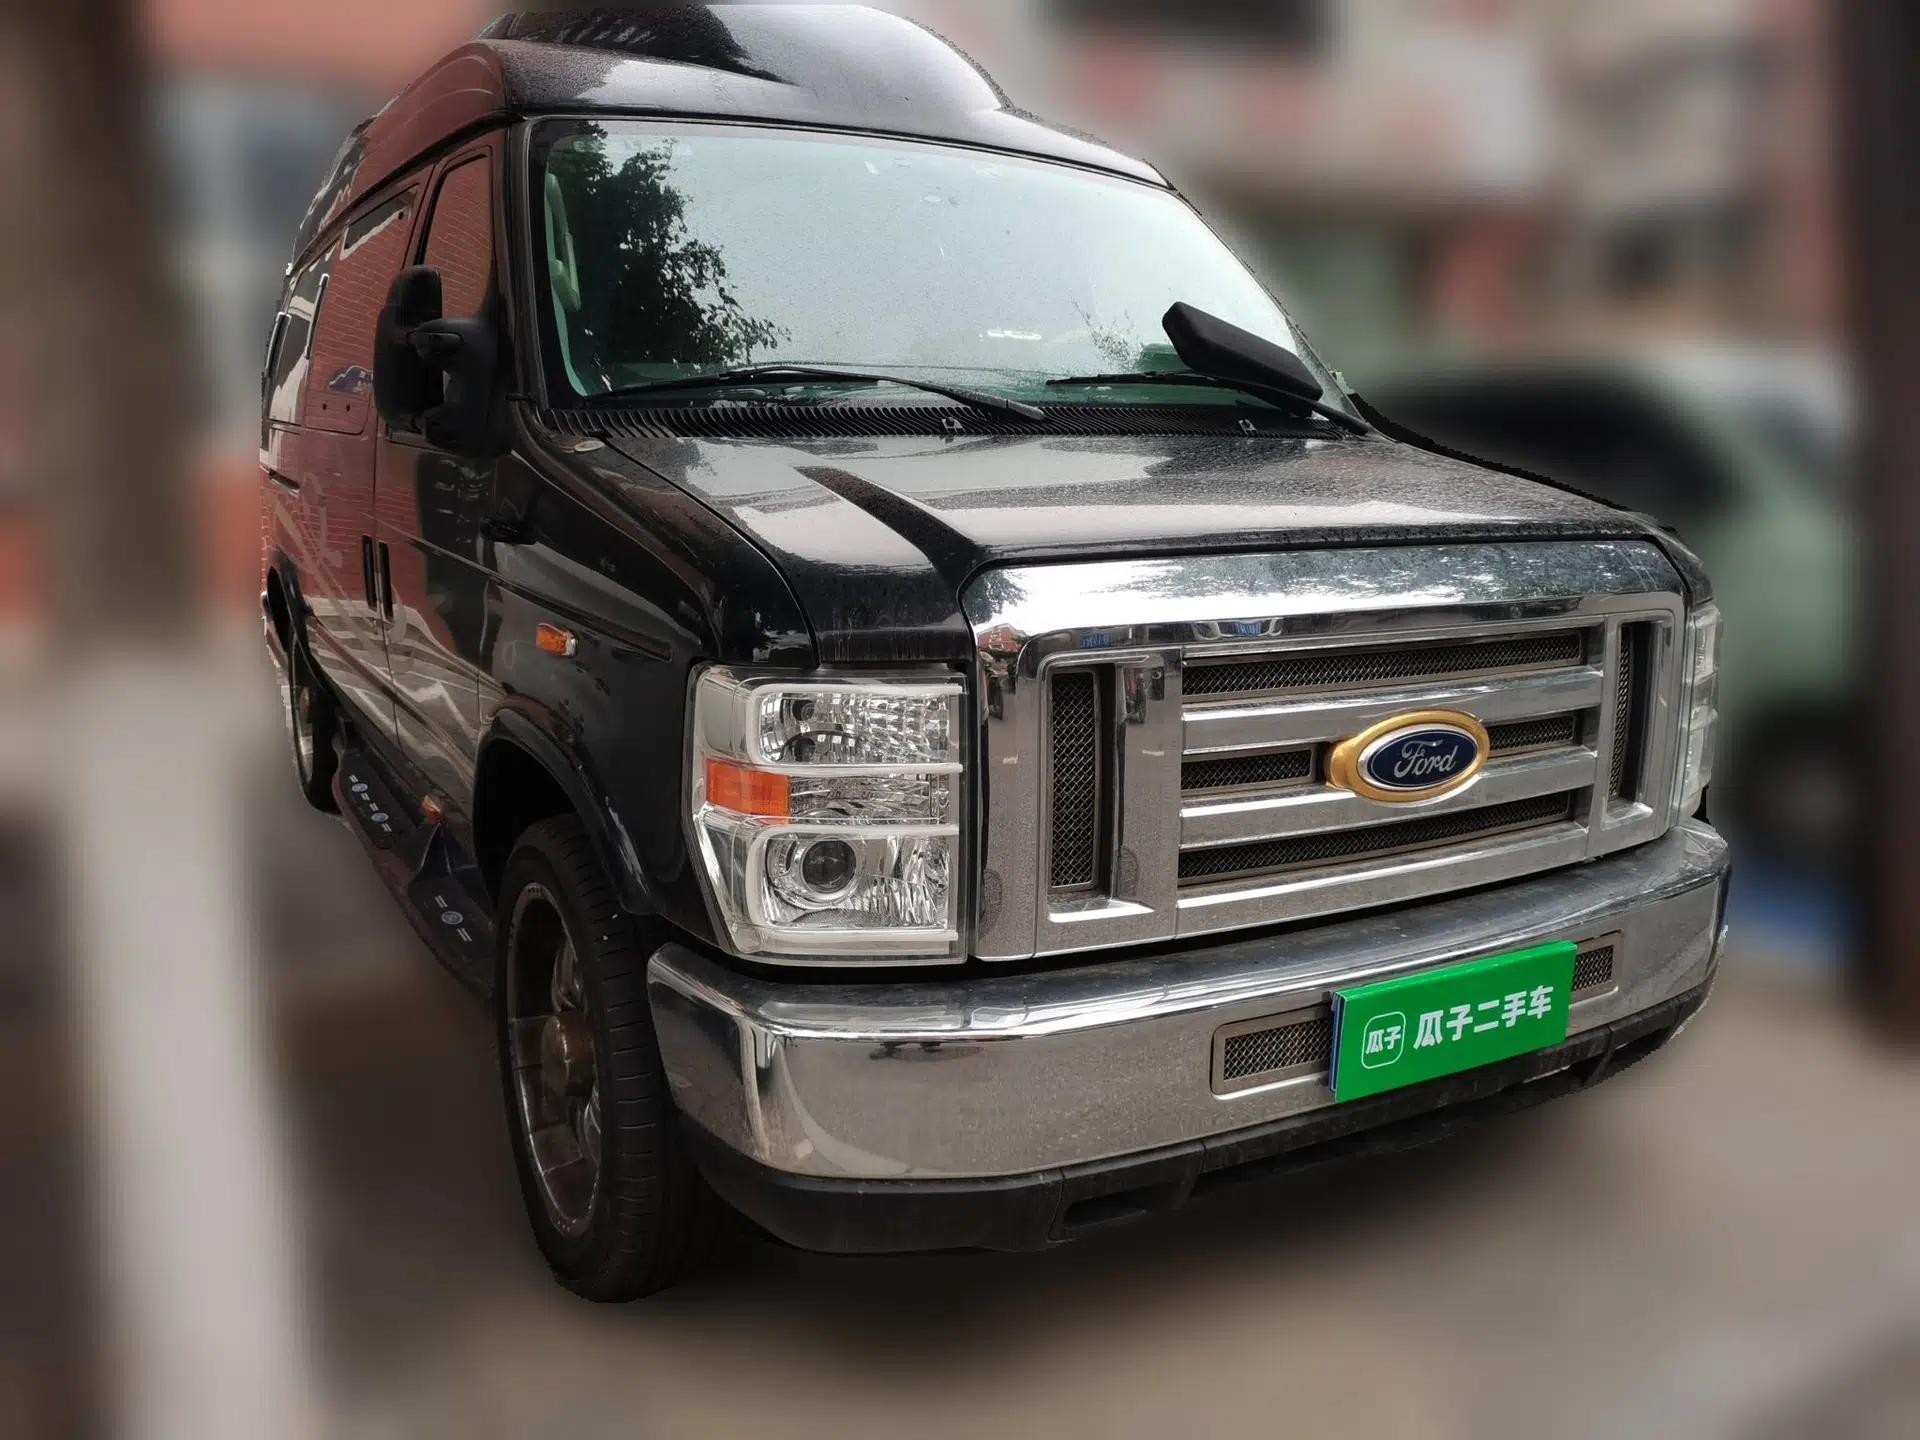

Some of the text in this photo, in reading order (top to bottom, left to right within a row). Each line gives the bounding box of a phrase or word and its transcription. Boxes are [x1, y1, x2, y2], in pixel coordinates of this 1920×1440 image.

[1393, 739, 1458, 778] Ford
[1413, 986, 1554, 1050] 瓜子二手车
[1365, 1025, 1402, 1055] 瓜子
